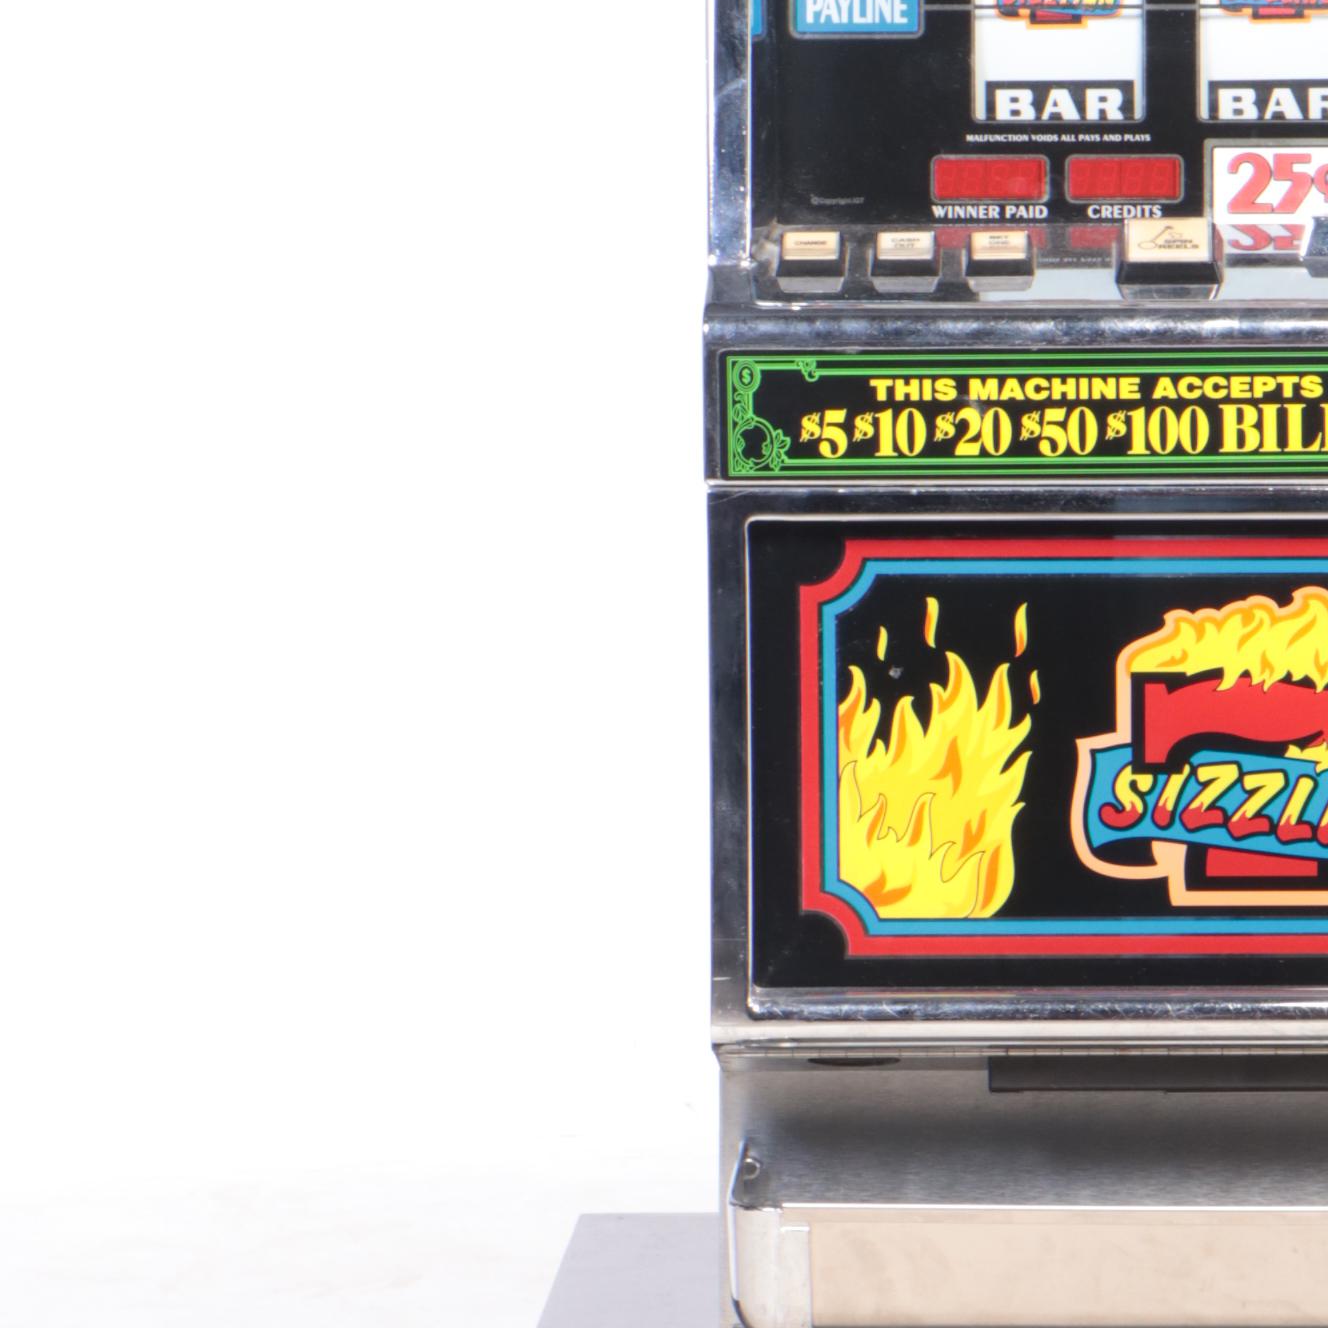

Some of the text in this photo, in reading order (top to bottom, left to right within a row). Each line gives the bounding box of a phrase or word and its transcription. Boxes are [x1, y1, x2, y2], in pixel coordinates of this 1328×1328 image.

[995, 88, 1124, 120] BAR
[965, 134, 1151, 142] MALFUNCTION VOIDS ALL PAYS AND PLAYS
[932, 205, 1048, 219] WINNER PAID
[1087, 205, 1162, 219] CREDITS
[870, 375, 1324, 401] THIS MACHINE ACCEPTS
[800, 408, 848, 458] $5
[853, 407, 927, 457] $10
[934, 407, 1012, 456] $20
[1020, 406, 1098, 456] $50
[1106, 405, 1210, 455] $100
